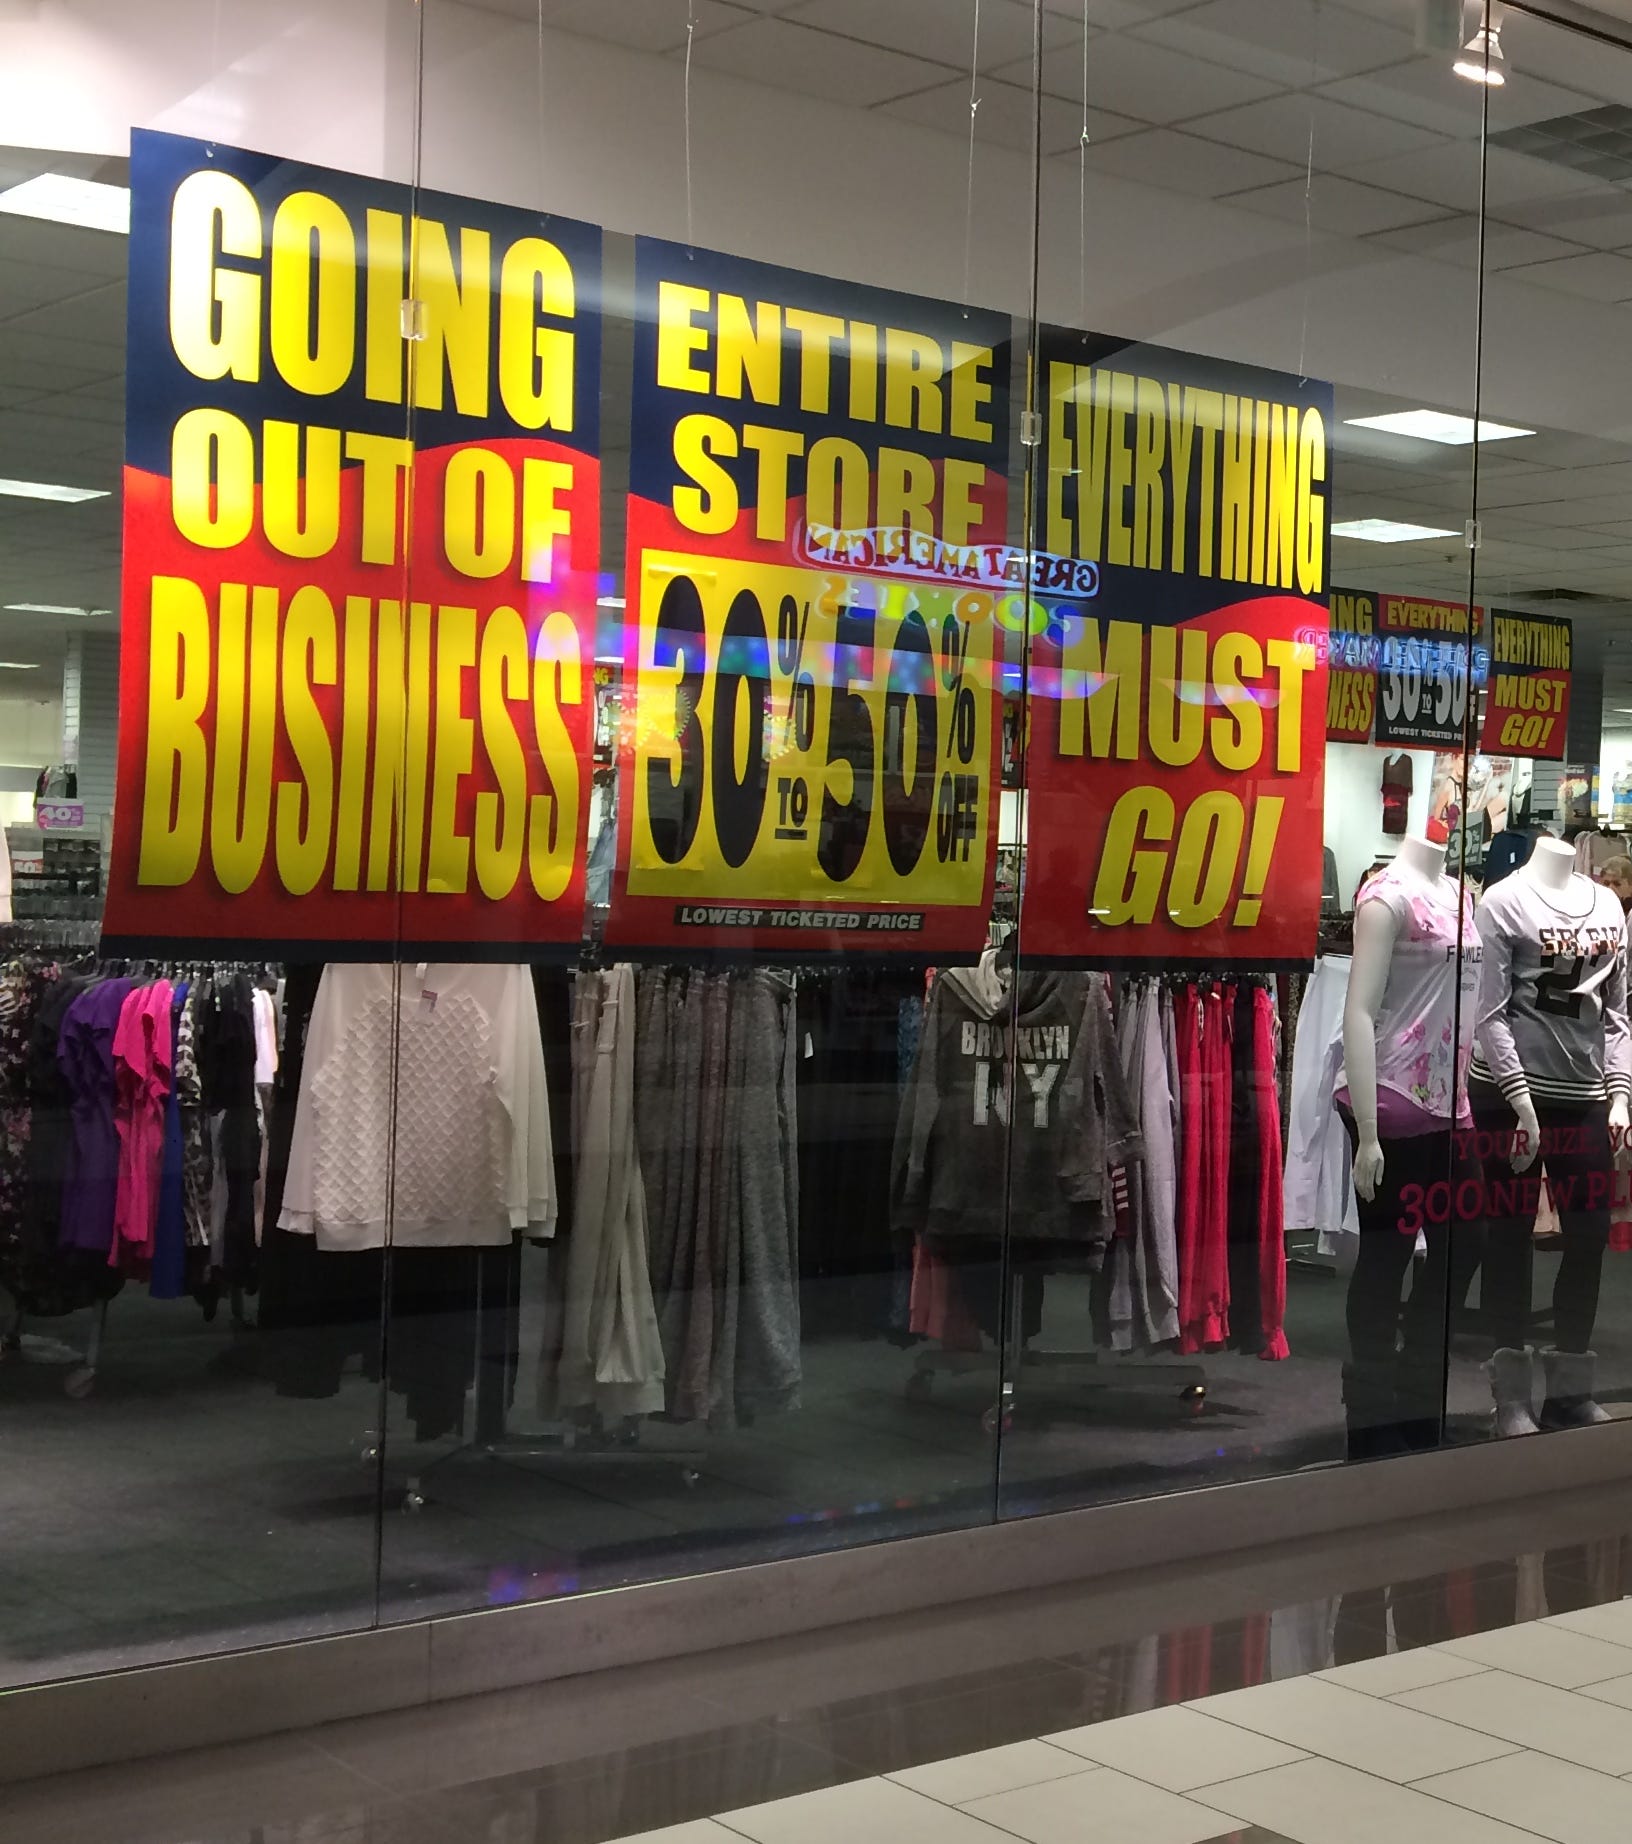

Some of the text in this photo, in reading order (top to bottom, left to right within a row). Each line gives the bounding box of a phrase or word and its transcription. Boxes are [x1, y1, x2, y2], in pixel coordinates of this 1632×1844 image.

[168, 169, 577, 433] GOING
[657, 281, 994, 444] ENTIRE
[171, 408, 575, 583] OUT OF
[671, 413, 986, 546] STORE
[1045, 360, 1326, 597] EVERYTHING
[1329, 593, 1373, 636] ING
[1387, 600, 1479, 636] EVERYTHING
[1494, 616, 1570, 671] EVERYTHING
[1057, 614, 1315, 773] MUST
[1326, 669, 1375, 732] NESS
[1435, 641, 1475, 727] 50
[1495, 674, 1567, 713] MUST
[137, 575, 583, 902] BUSINESS
[1500, 714, 1555, 749] GO!
[777, 776, 809, 828] TO
[936, 770, 979, 864] OFF
[1091, 785, 1285, 928] GO!
[681, 907, 921, 929] LOWEST TICKETED PRICE
[961, 1020, 1070, 1060] BROOKLYN
[1452, 1130, 1531, 1160] YOUR
